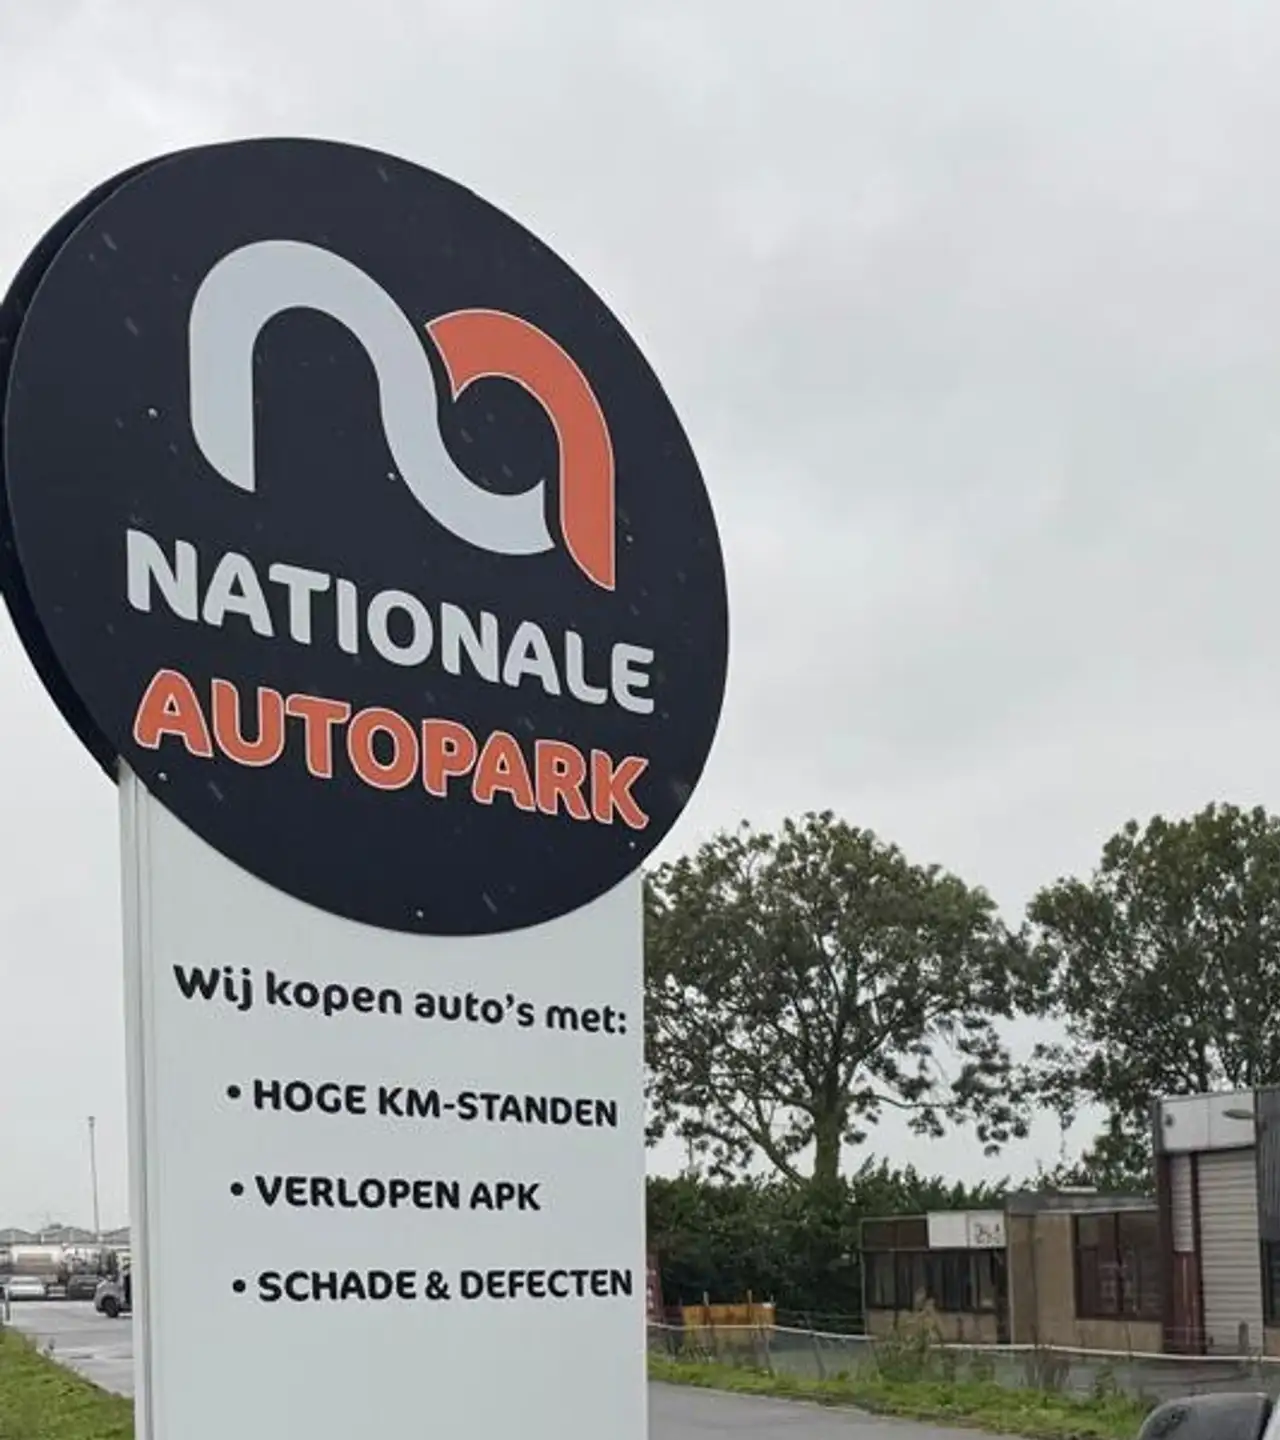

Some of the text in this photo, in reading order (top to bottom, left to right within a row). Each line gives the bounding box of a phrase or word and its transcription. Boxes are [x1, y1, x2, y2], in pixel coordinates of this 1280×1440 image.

[126, 529, 655, 715] NATIONALE
[133, 668, 649, 829] AUTOPARK
[173, 964, 253, 1012] Wij
[266, 970, 401, 1017] kopen
[546, 1005, 628, 1035] met:
[253, 1079, 618, 1127] HOGE KM-STANDEN
[255, 1175, 541, 1211] VERLOPEN APK
[258, 1269, 634, 1302] SCHADE & DEFECTEN
